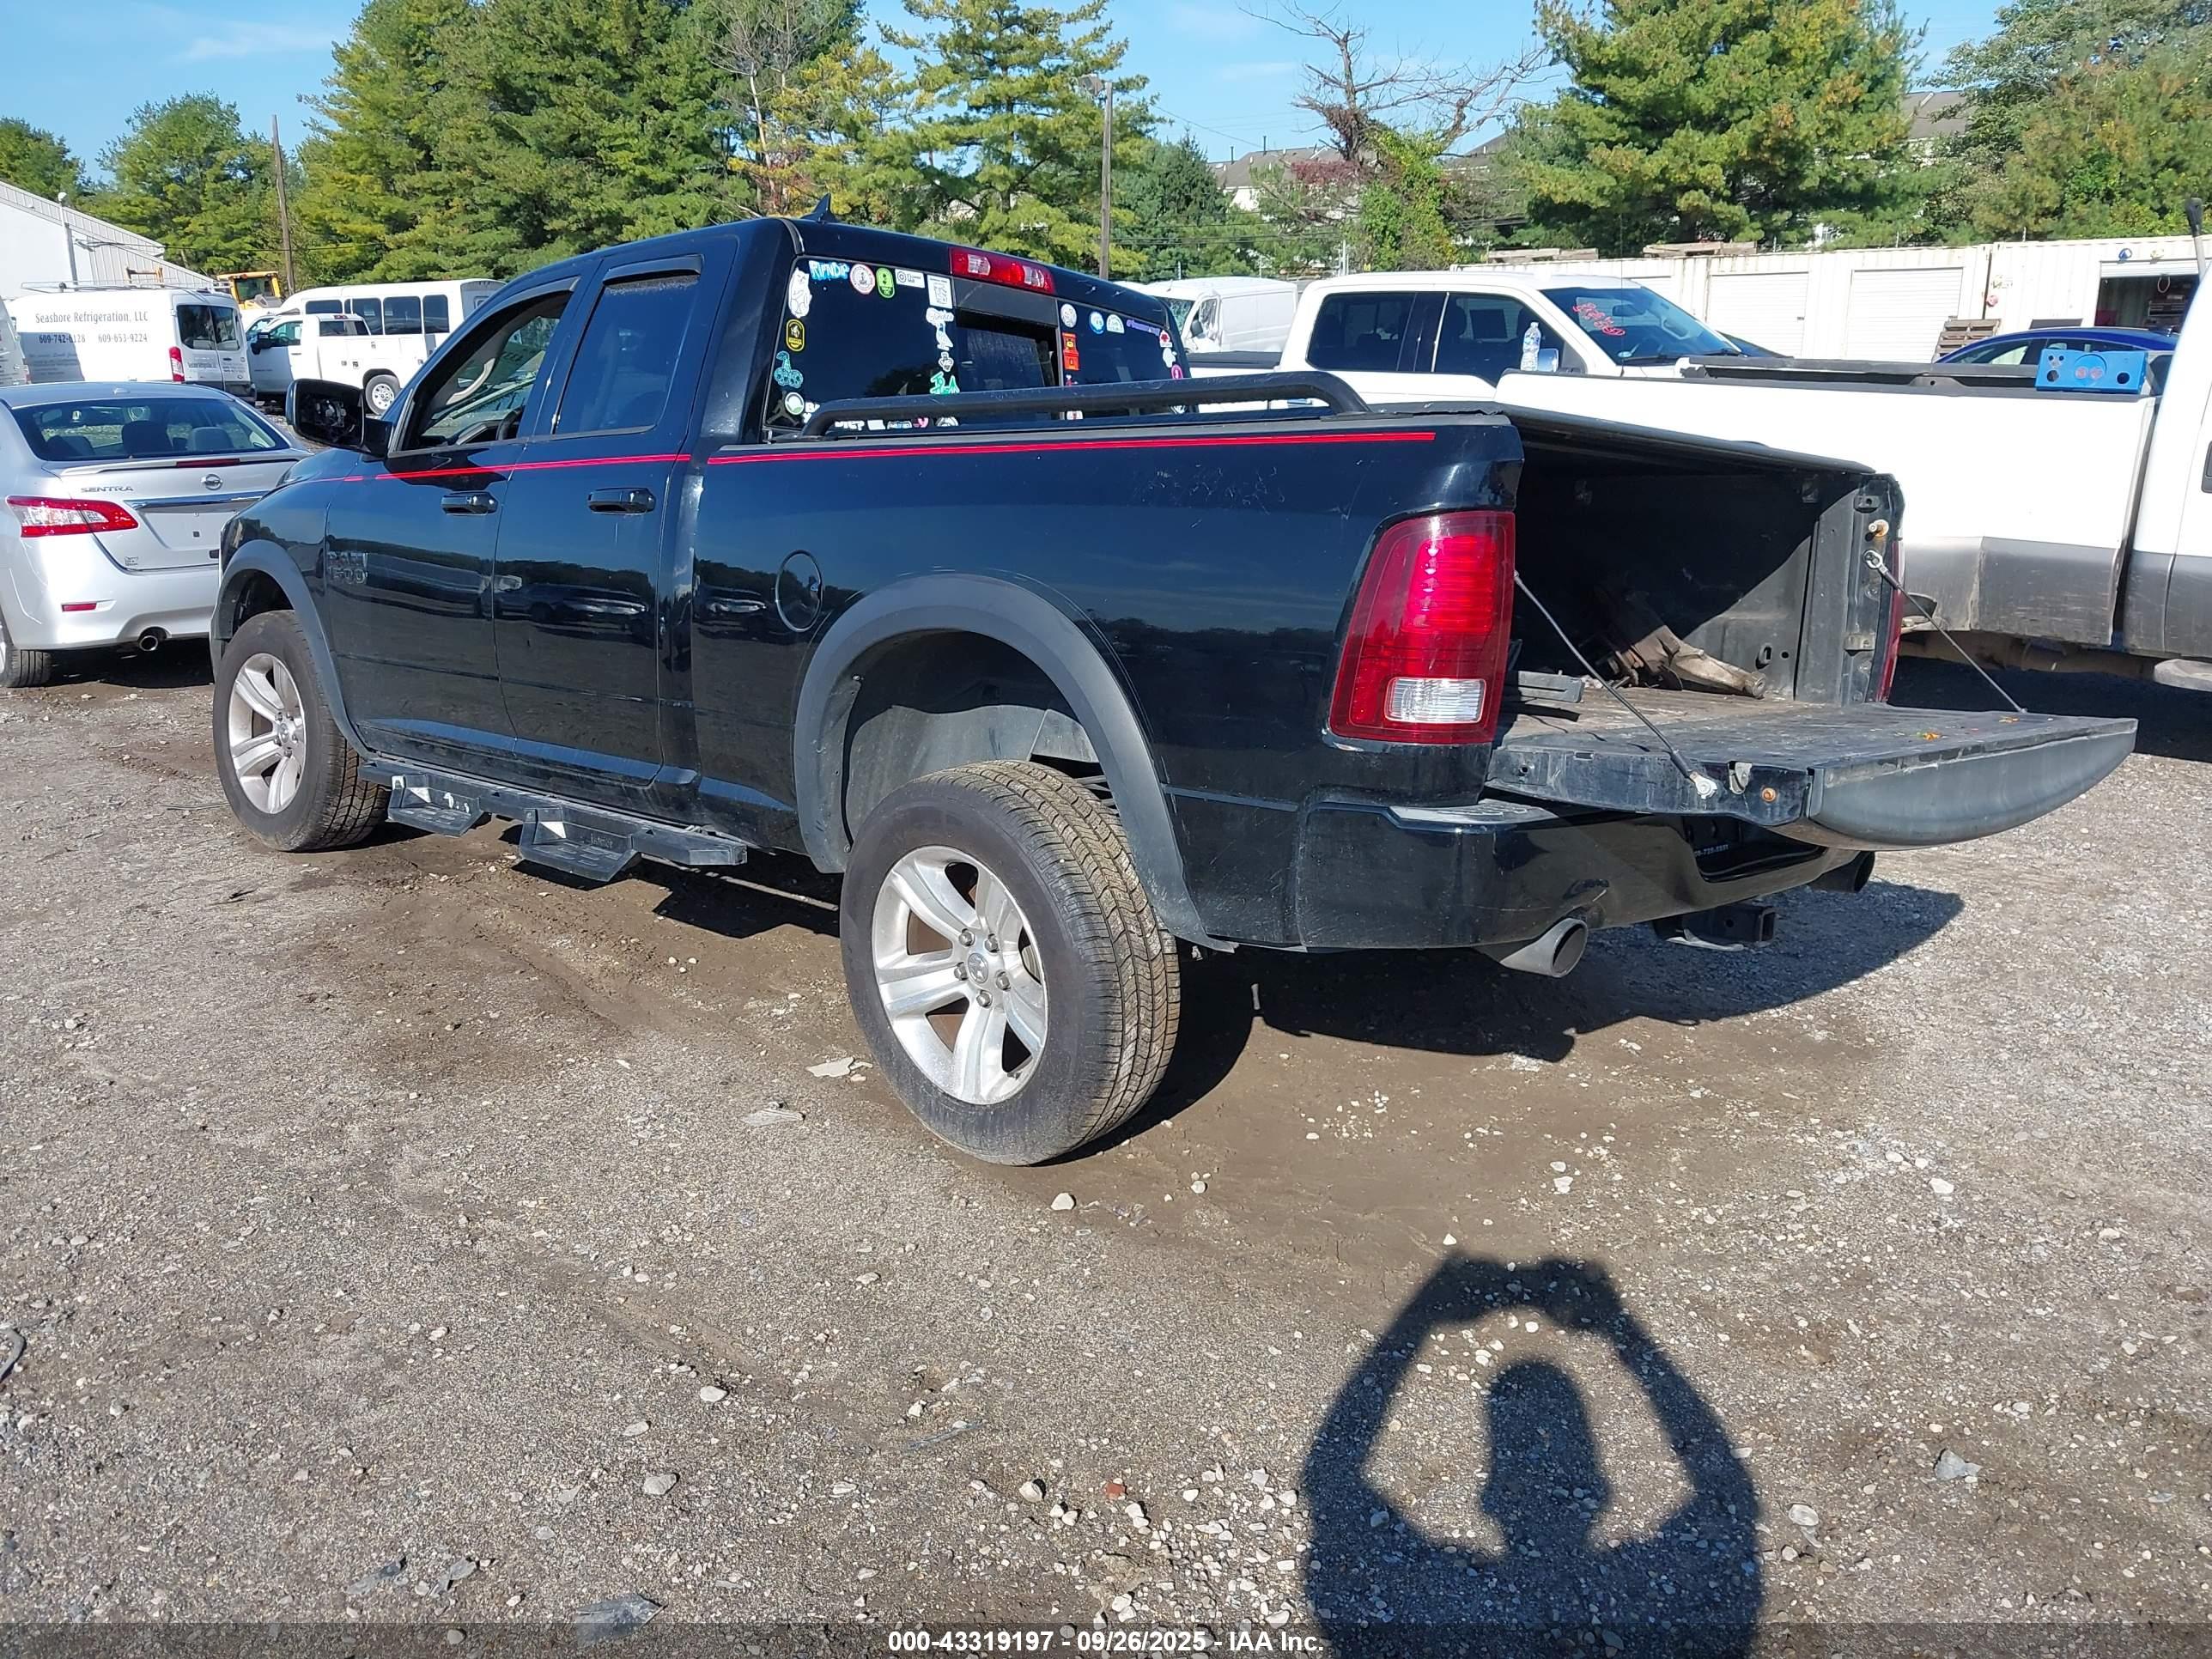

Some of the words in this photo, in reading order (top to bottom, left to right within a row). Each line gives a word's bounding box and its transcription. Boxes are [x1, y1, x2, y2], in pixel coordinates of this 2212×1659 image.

[35, 313, 71, 324] Seashore
[74, 312, 131, 324] Refrigeration,
[135, 312, 149, 321] LLC
